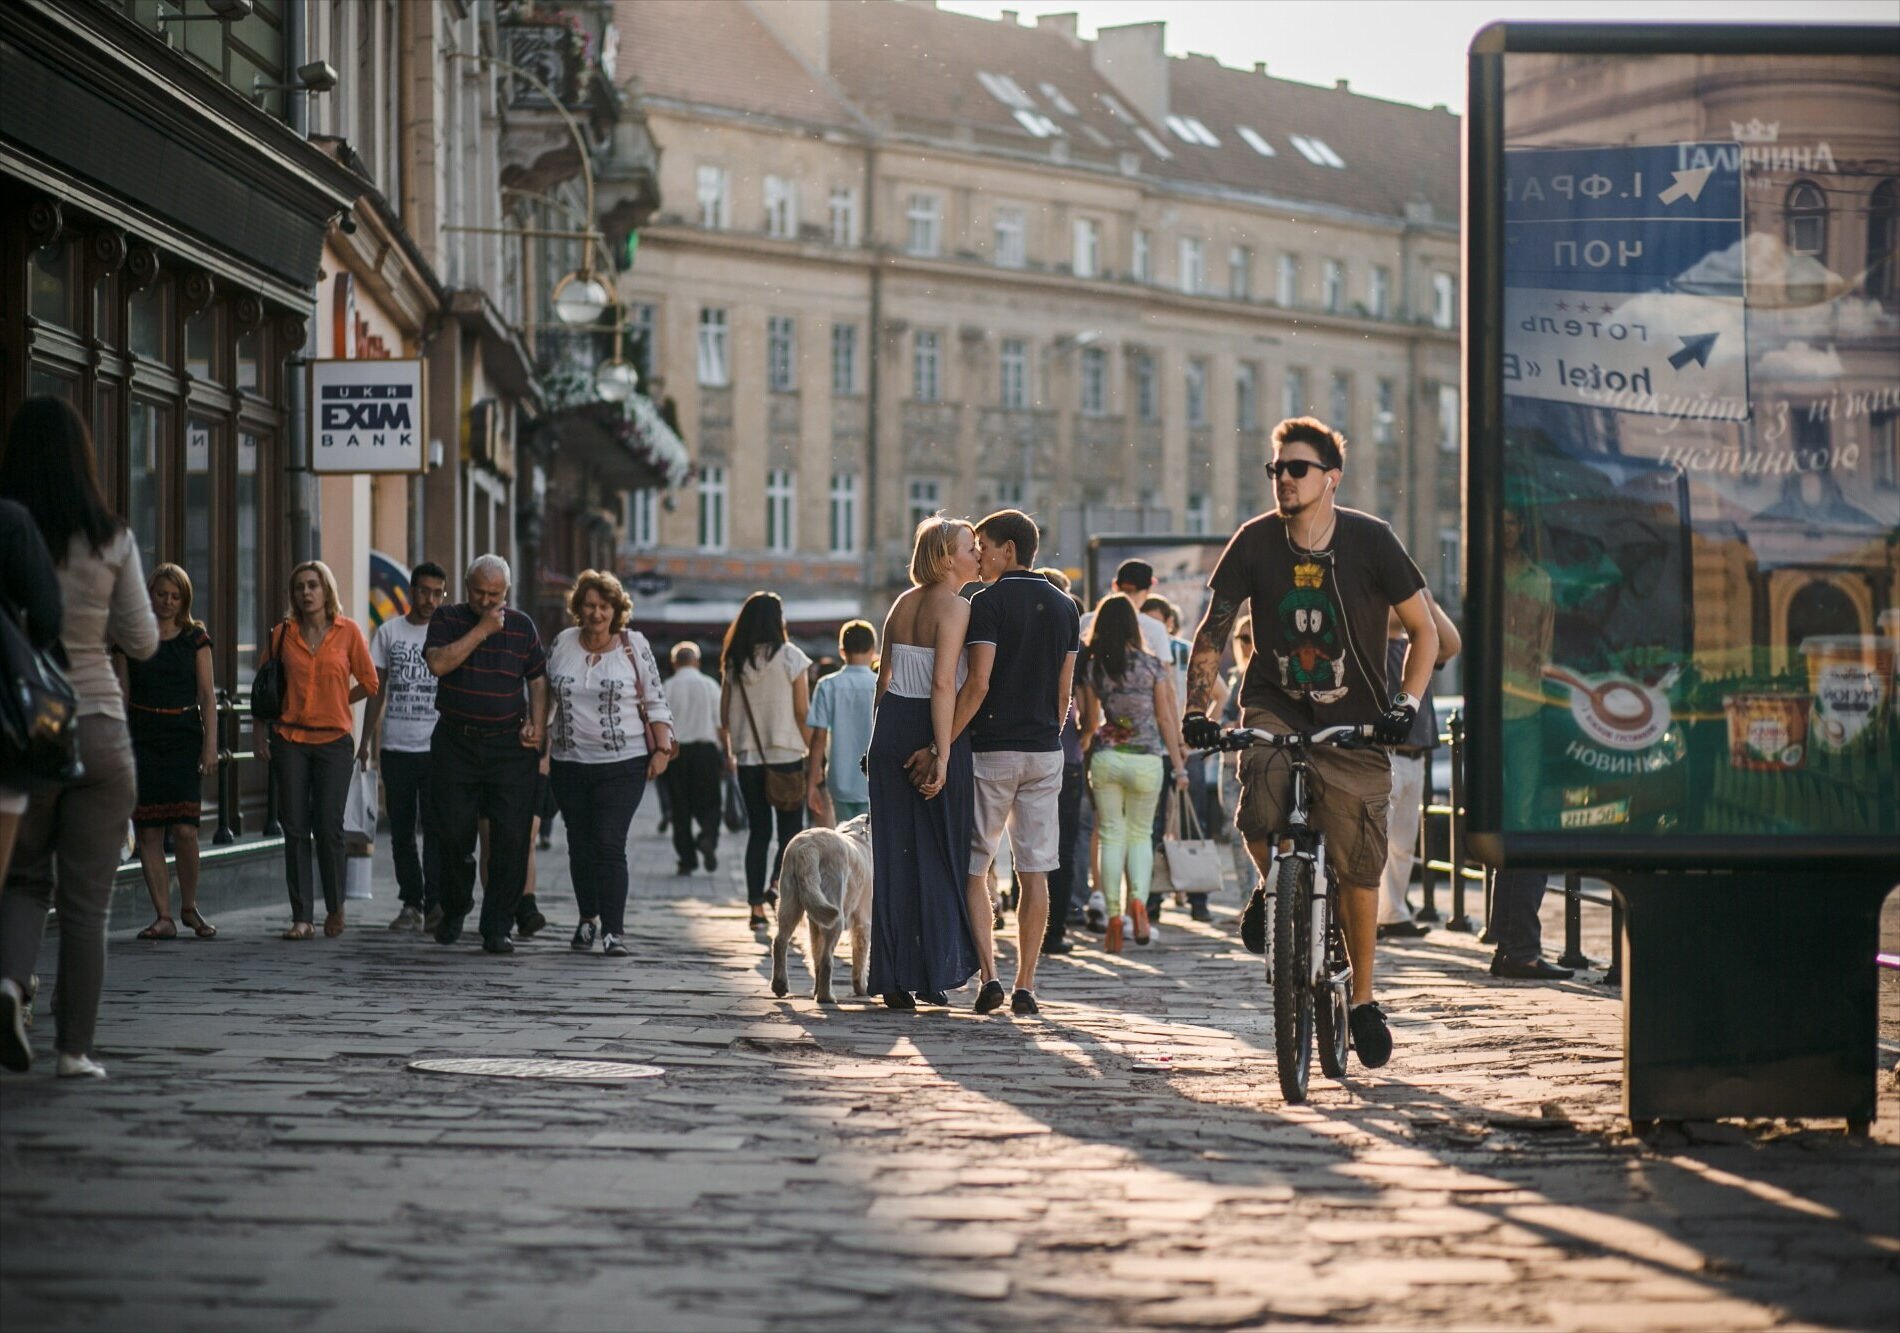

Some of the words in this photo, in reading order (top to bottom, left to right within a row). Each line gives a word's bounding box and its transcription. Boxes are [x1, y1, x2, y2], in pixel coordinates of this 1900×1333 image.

[339, 387, 398, 398] UKR
[321, 403, 412, 431] EXIM
[321, 433, 412, 448] BANK
[1564, 740, 1673, 774] НОВИНКА
